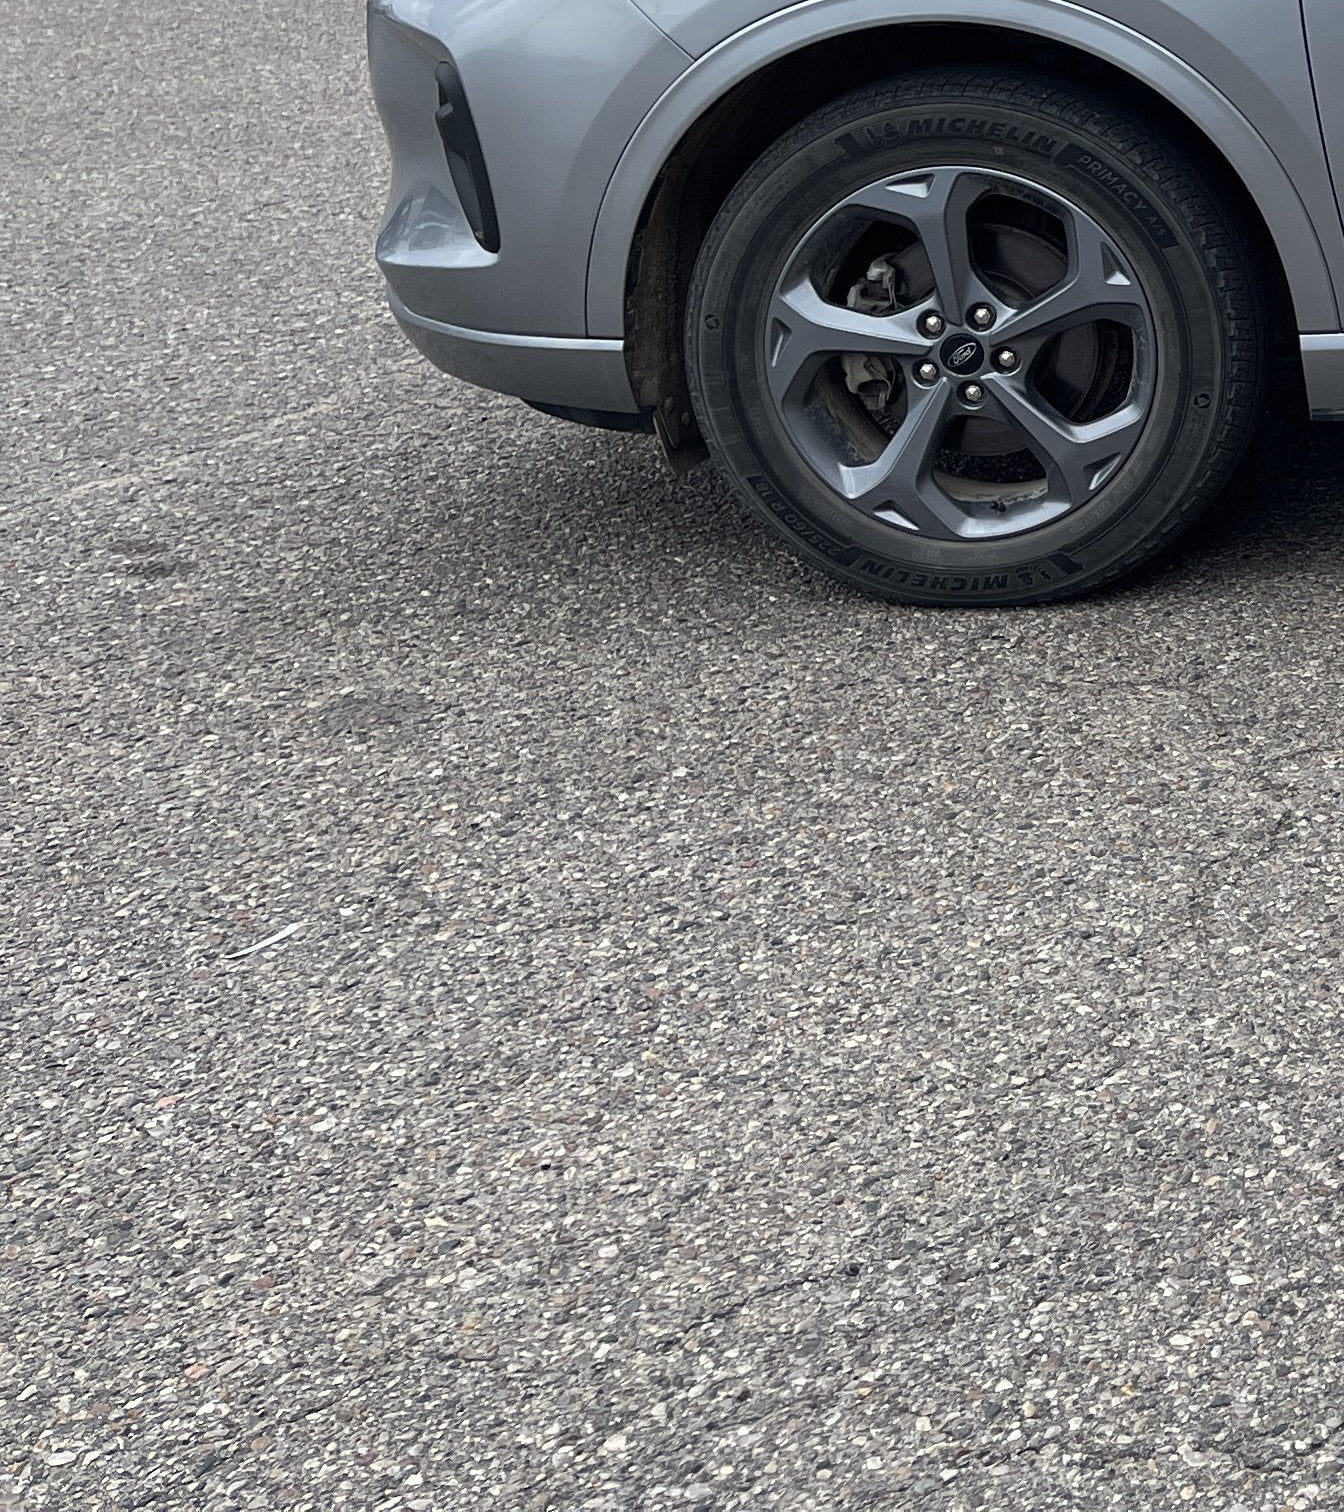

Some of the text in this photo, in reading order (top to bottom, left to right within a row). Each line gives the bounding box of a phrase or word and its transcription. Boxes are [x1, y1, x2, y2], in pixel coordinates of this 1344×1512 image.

[906, 117, 1059, 153] MICHELIN
[1076, 154, 1148, 210] PRIMACY
[784, 514, 842, 555] 225/60
[860, 558, 1009, 591] MICHELIN
